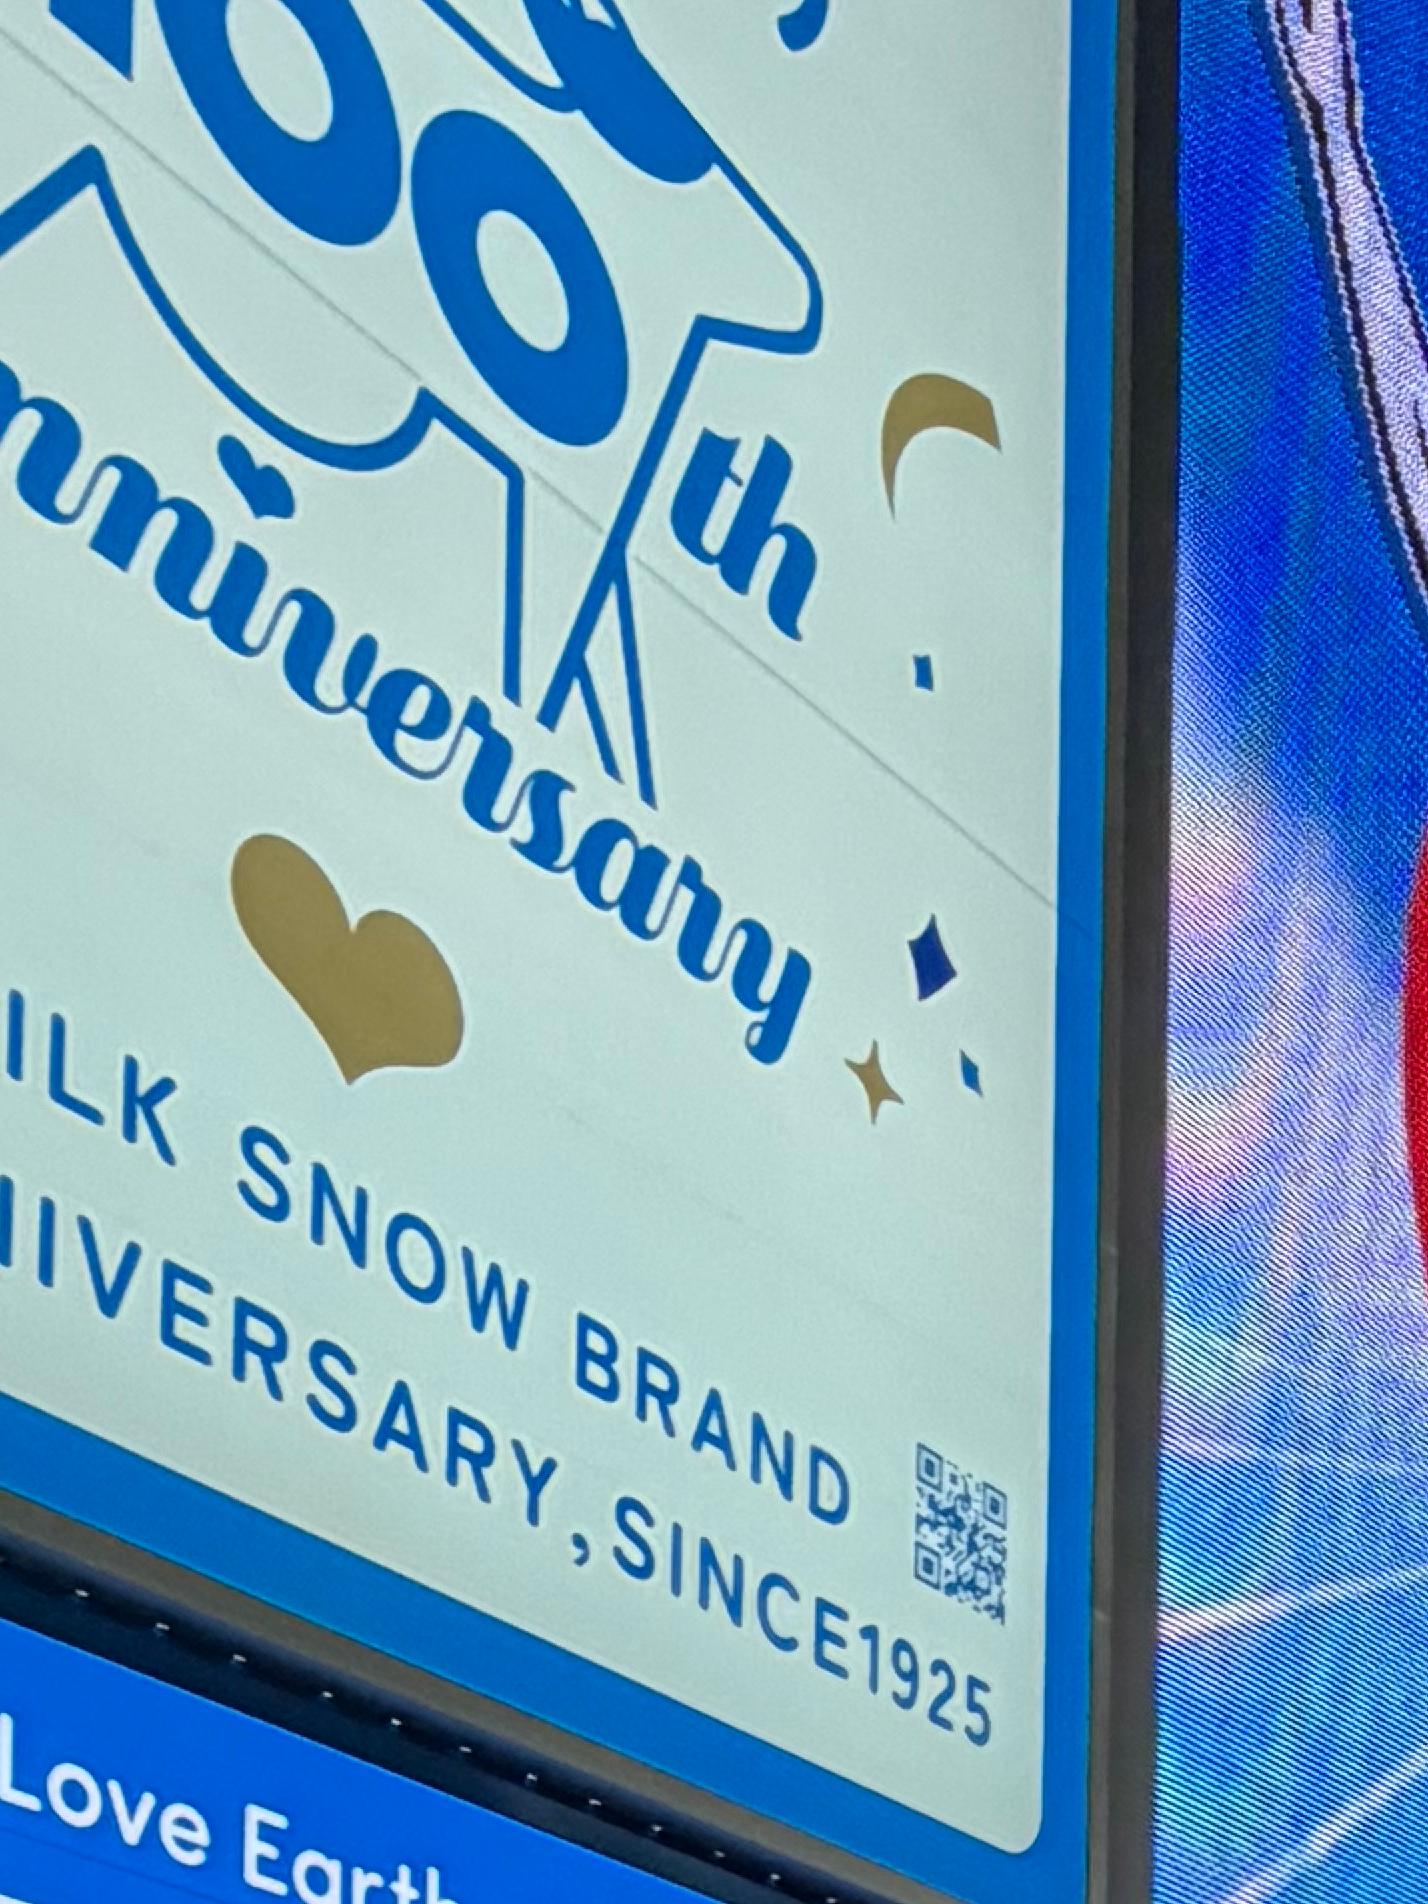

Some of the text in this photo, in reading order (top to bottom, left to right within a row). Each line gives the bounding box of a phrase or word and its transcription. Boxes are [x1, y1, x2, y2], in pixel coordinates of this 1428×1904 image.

[237, 1124, 531, 1352] SNOW
[575, 1310, 852, 1528] BRAND
[0, 1711, 210, 1867] Love
